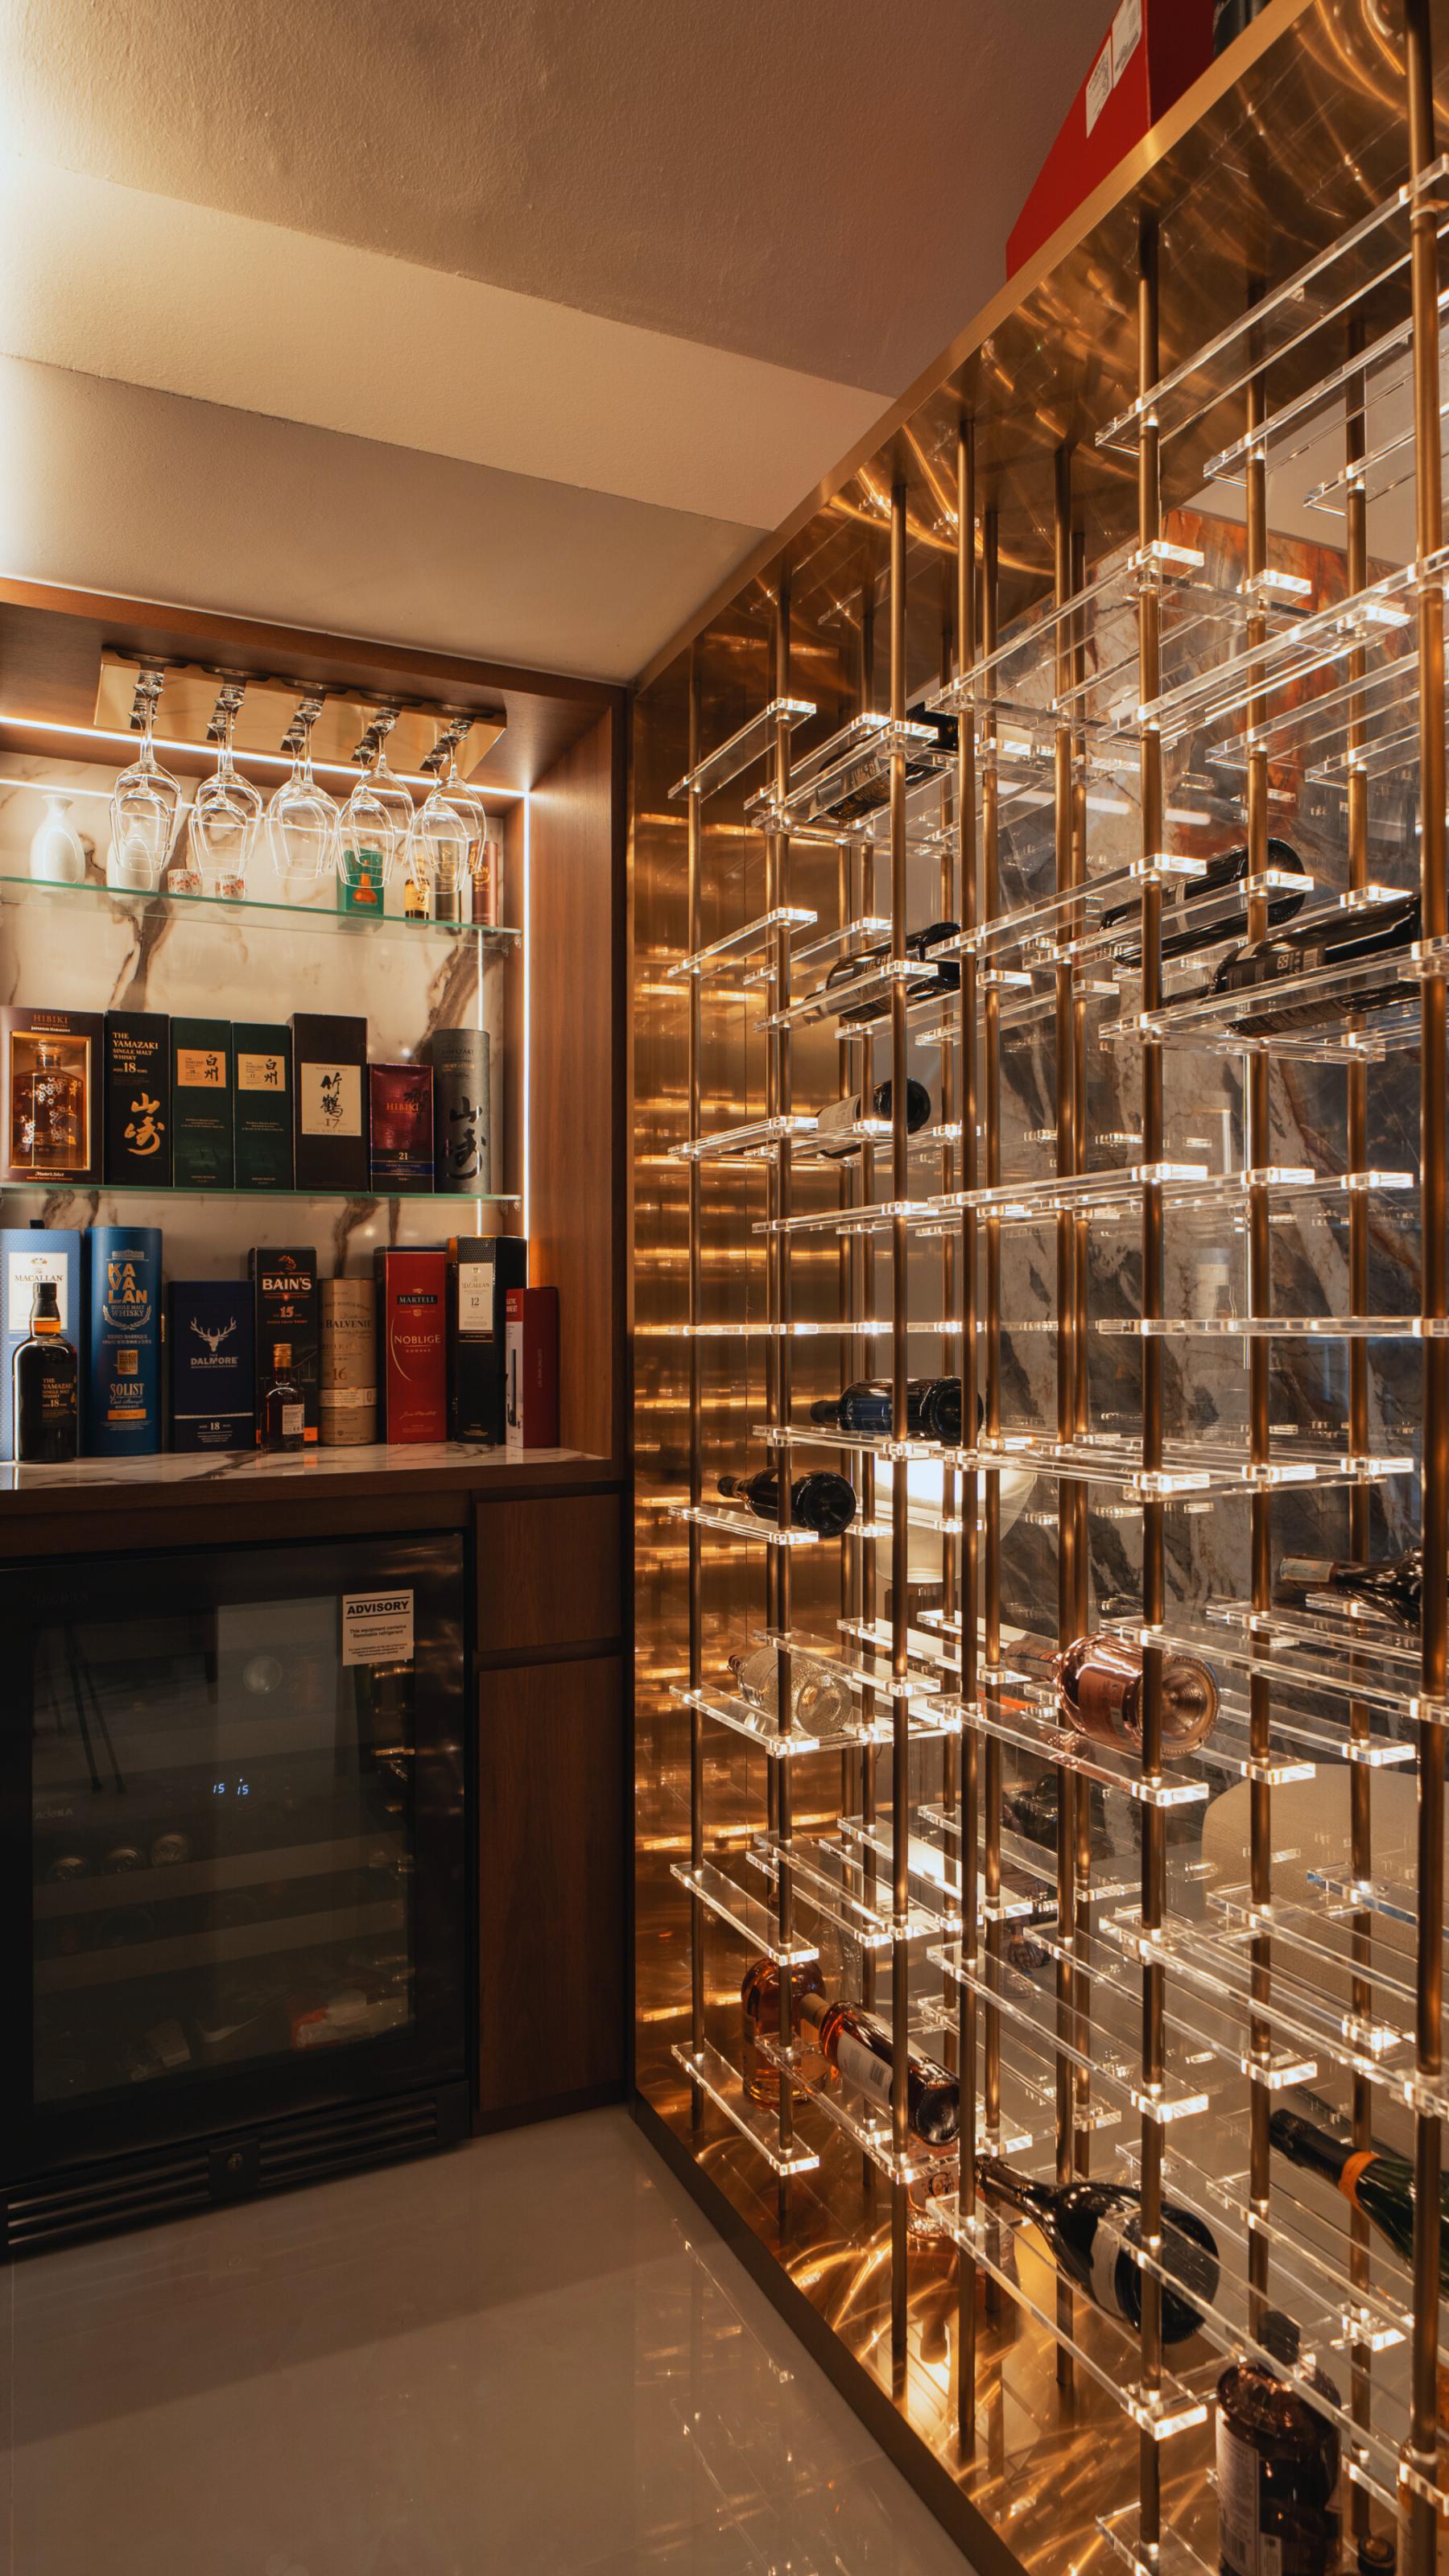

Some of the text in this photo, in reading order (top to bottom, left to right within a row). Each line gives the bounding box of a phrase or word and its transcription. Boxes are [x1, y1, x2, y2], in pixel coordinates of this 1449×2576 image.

[33, 1014, 68, 1024] HIBIKI
[113, 1040, 159, 1050] YAMAZAKI
[124, 1063, 136, 1073] 18
[325, 1118, 341, 1129] 17
[398, 1152, 408, 1160] 21
[262, 1278, 312, 1290] BAIN'S
[470, 1297, 480, 1307] 12
[279, 1306, 295, 1318] 15
[394, 1334, 441, 1344] NOBLIGE
[190, 1356, 239, 1366] DALMORE
[109, 1383, 144, 1399] SOLIST
[210, 1422, 221, 1430] 18
[347, 1600, 410, 1616] ADVISORY
[213, 1783, 250, 1795] 15 15
